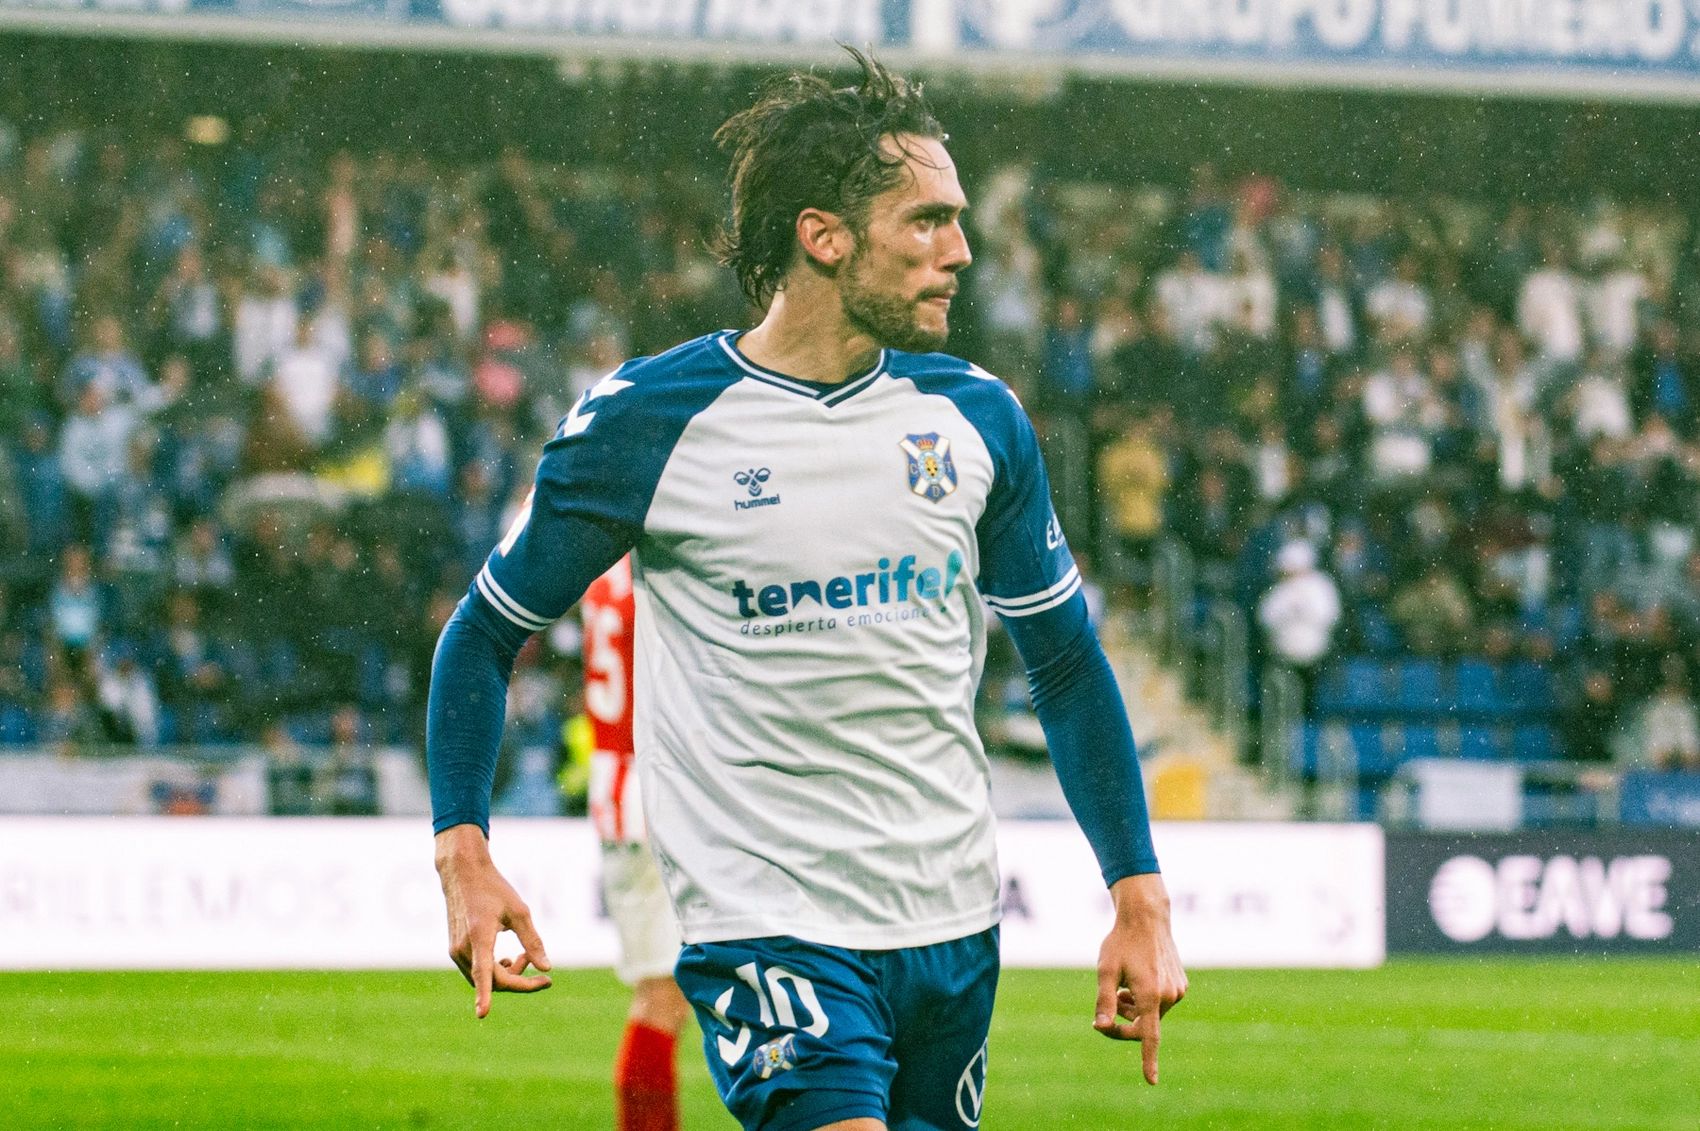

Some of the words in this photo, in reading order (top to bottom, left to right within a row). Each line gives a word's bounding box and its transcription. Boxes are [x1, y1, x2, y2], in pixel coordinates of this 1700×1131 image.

[734, 493, 781, 511] hummel
[741, 617, 837, 636] despierta
[736, 962, 829, 1039] 10
